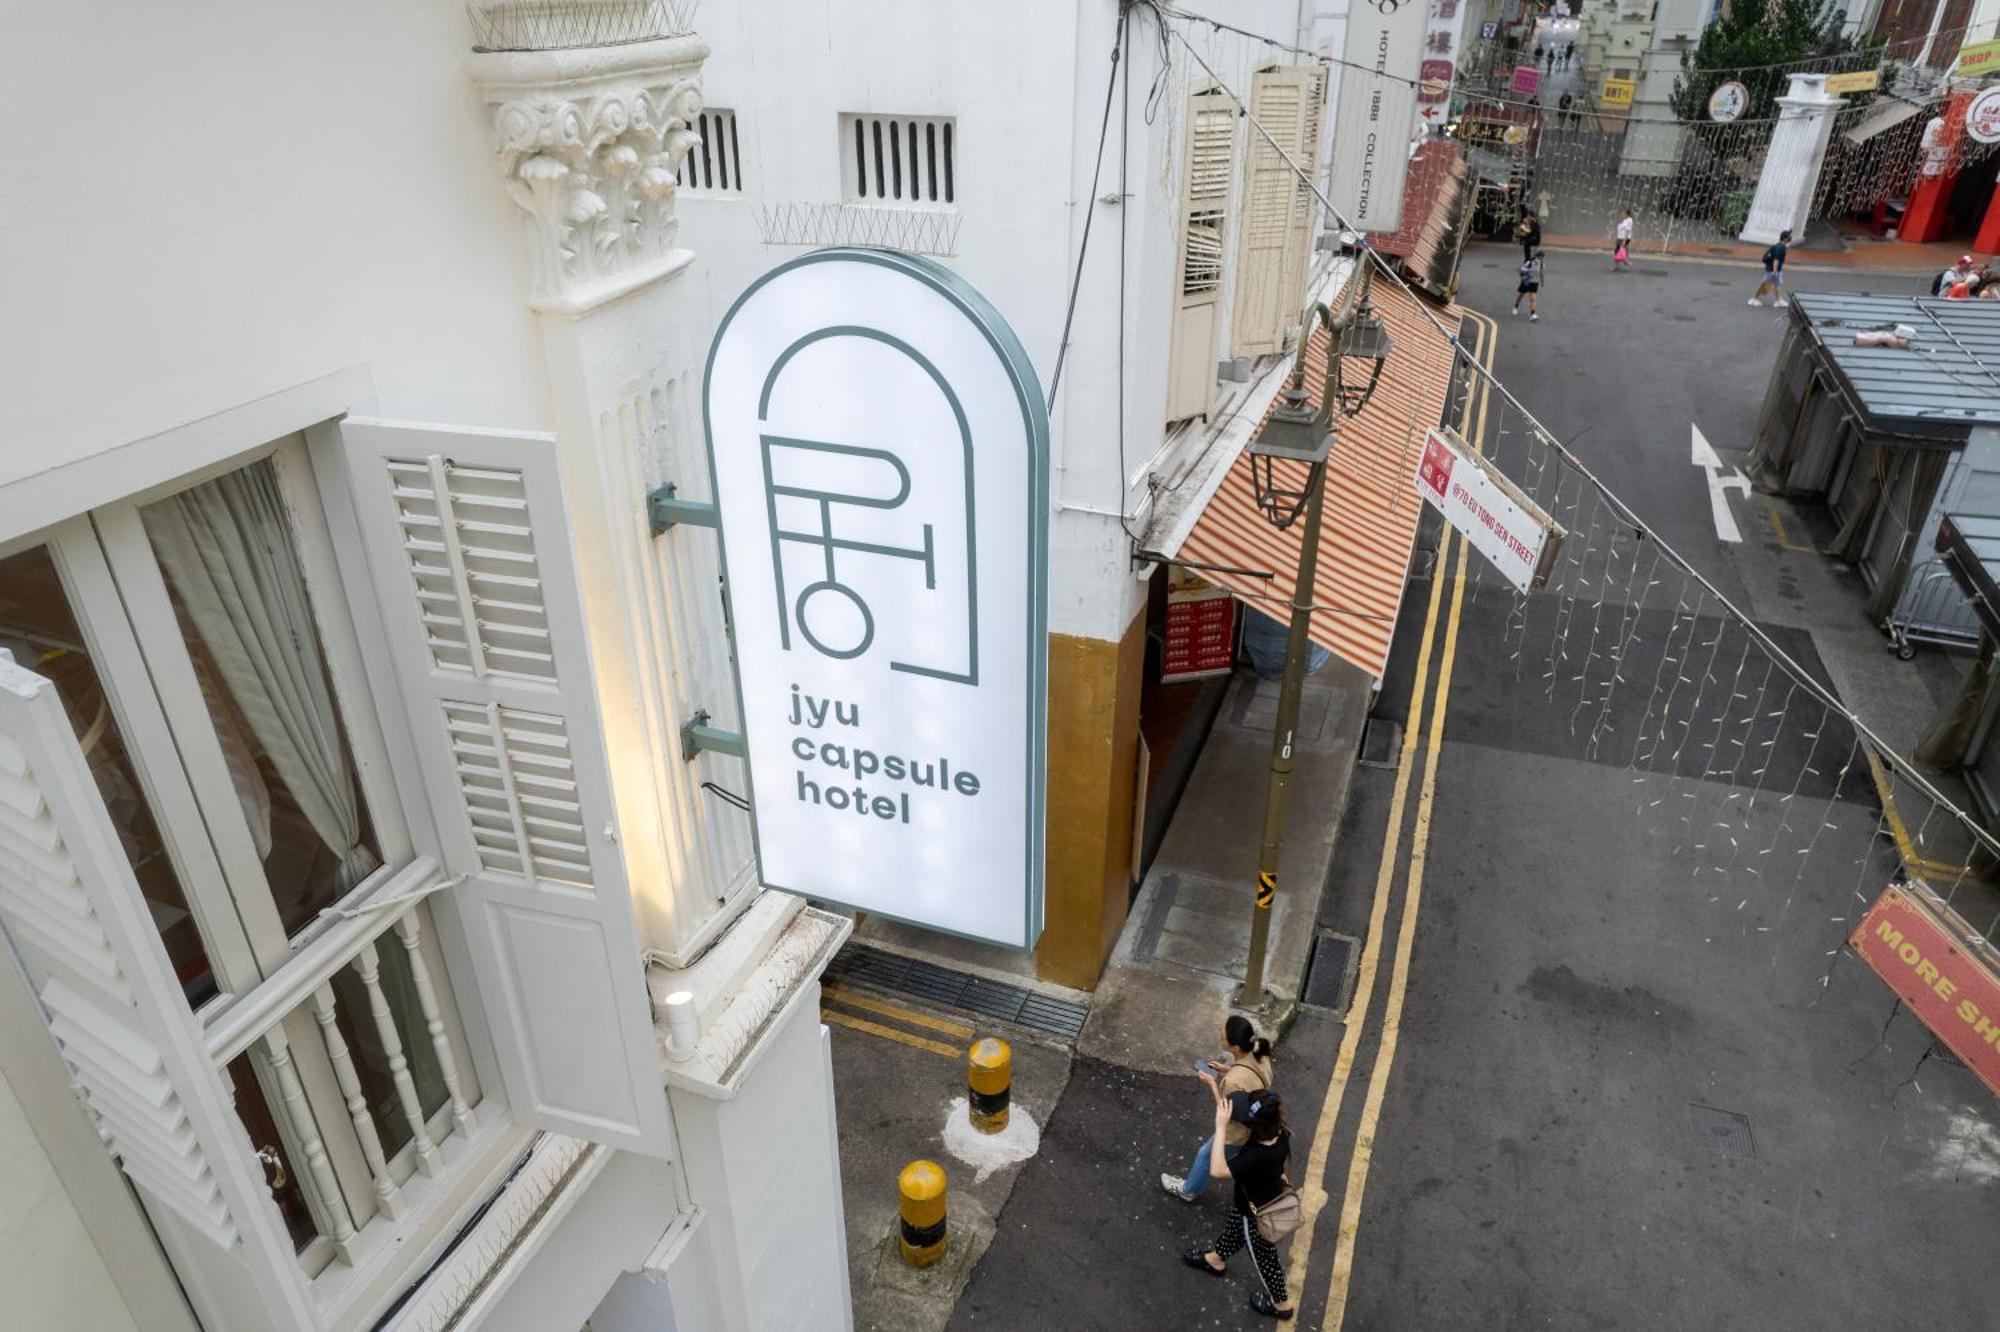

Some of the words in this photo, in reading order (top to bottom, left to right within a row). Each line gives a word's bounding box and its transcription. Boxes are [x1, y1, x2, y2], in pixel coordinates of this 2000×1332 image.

[1376, 30, 1389, 79] HOTEL
[1368, 90, 1382, 121] 1888
[1358, 132, 1377, 219] COLLECTION
[1477, 506, 1496, 530] TONG
[1494, 522, 1508, 543] SEN
[1507, 536, 1535, 565] STREET
[789, 683, 860, 728] jyu
[791, 737, 981, 796] capsule
[797, 770, 910, 824] hotel
[1875, 920, 1958, 1003] MORE
[1956, 1000, 2000, 1054] SH
